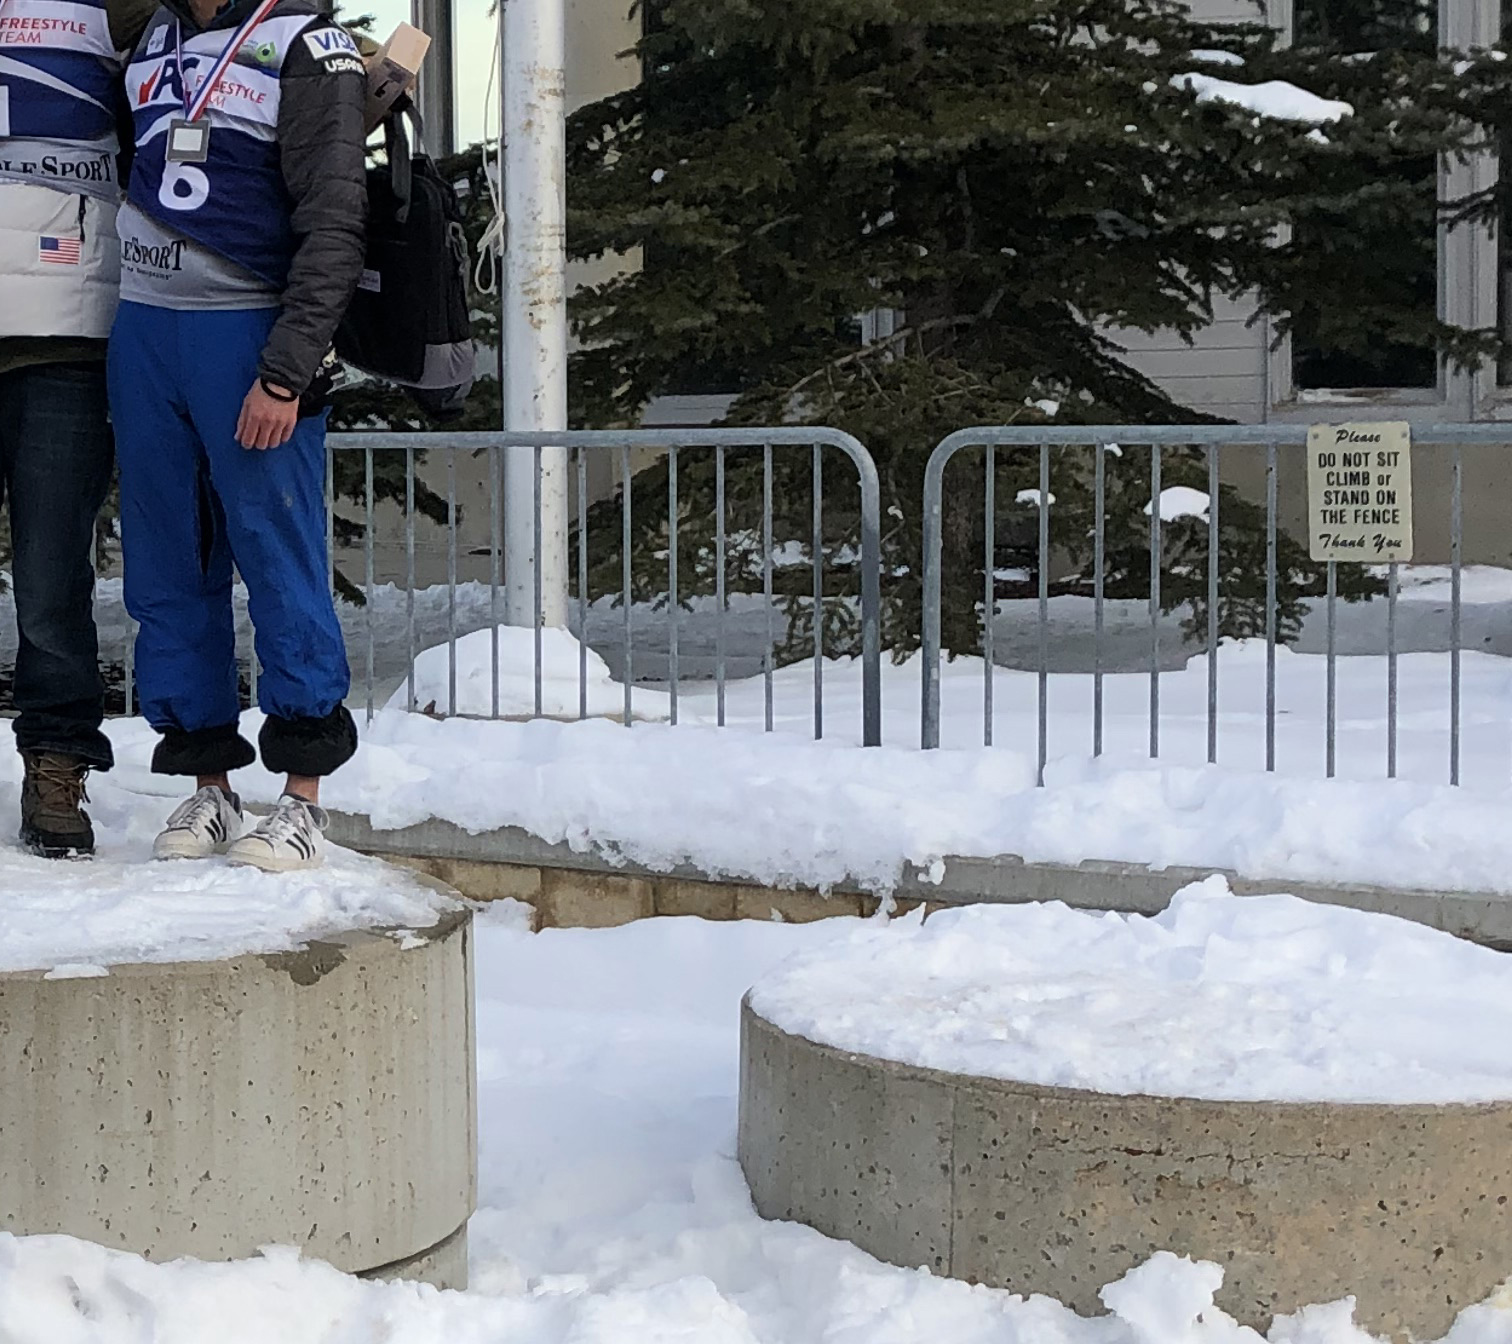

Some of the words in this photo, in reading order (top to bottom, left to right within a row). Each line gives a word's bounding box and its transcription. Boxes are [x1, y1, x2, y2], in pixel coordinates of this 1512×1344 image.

[195, 74, 267, 104] FESTYLE
[158, 159, 210, 211] 6
[1335, 429, 1381, 444] Please
[1318, 453, 1336, 468] DO
[1342, 452, 1371, 468] NOT
[1377, 451, 1400, 467] SIT
[1326, 471, 1370, 486] CLIMB
[1377, 474, 1392, 486] or
[1324, 490, 1370, 505] STAND
[1376, 490, 1396, 505] ON
[1320, 509, 1347, 524] THE
[1354, 509, 1400, 524] FENCE
[1319, 533, 1365, 549] Thank
[1372, 533, 1402, 553] You
